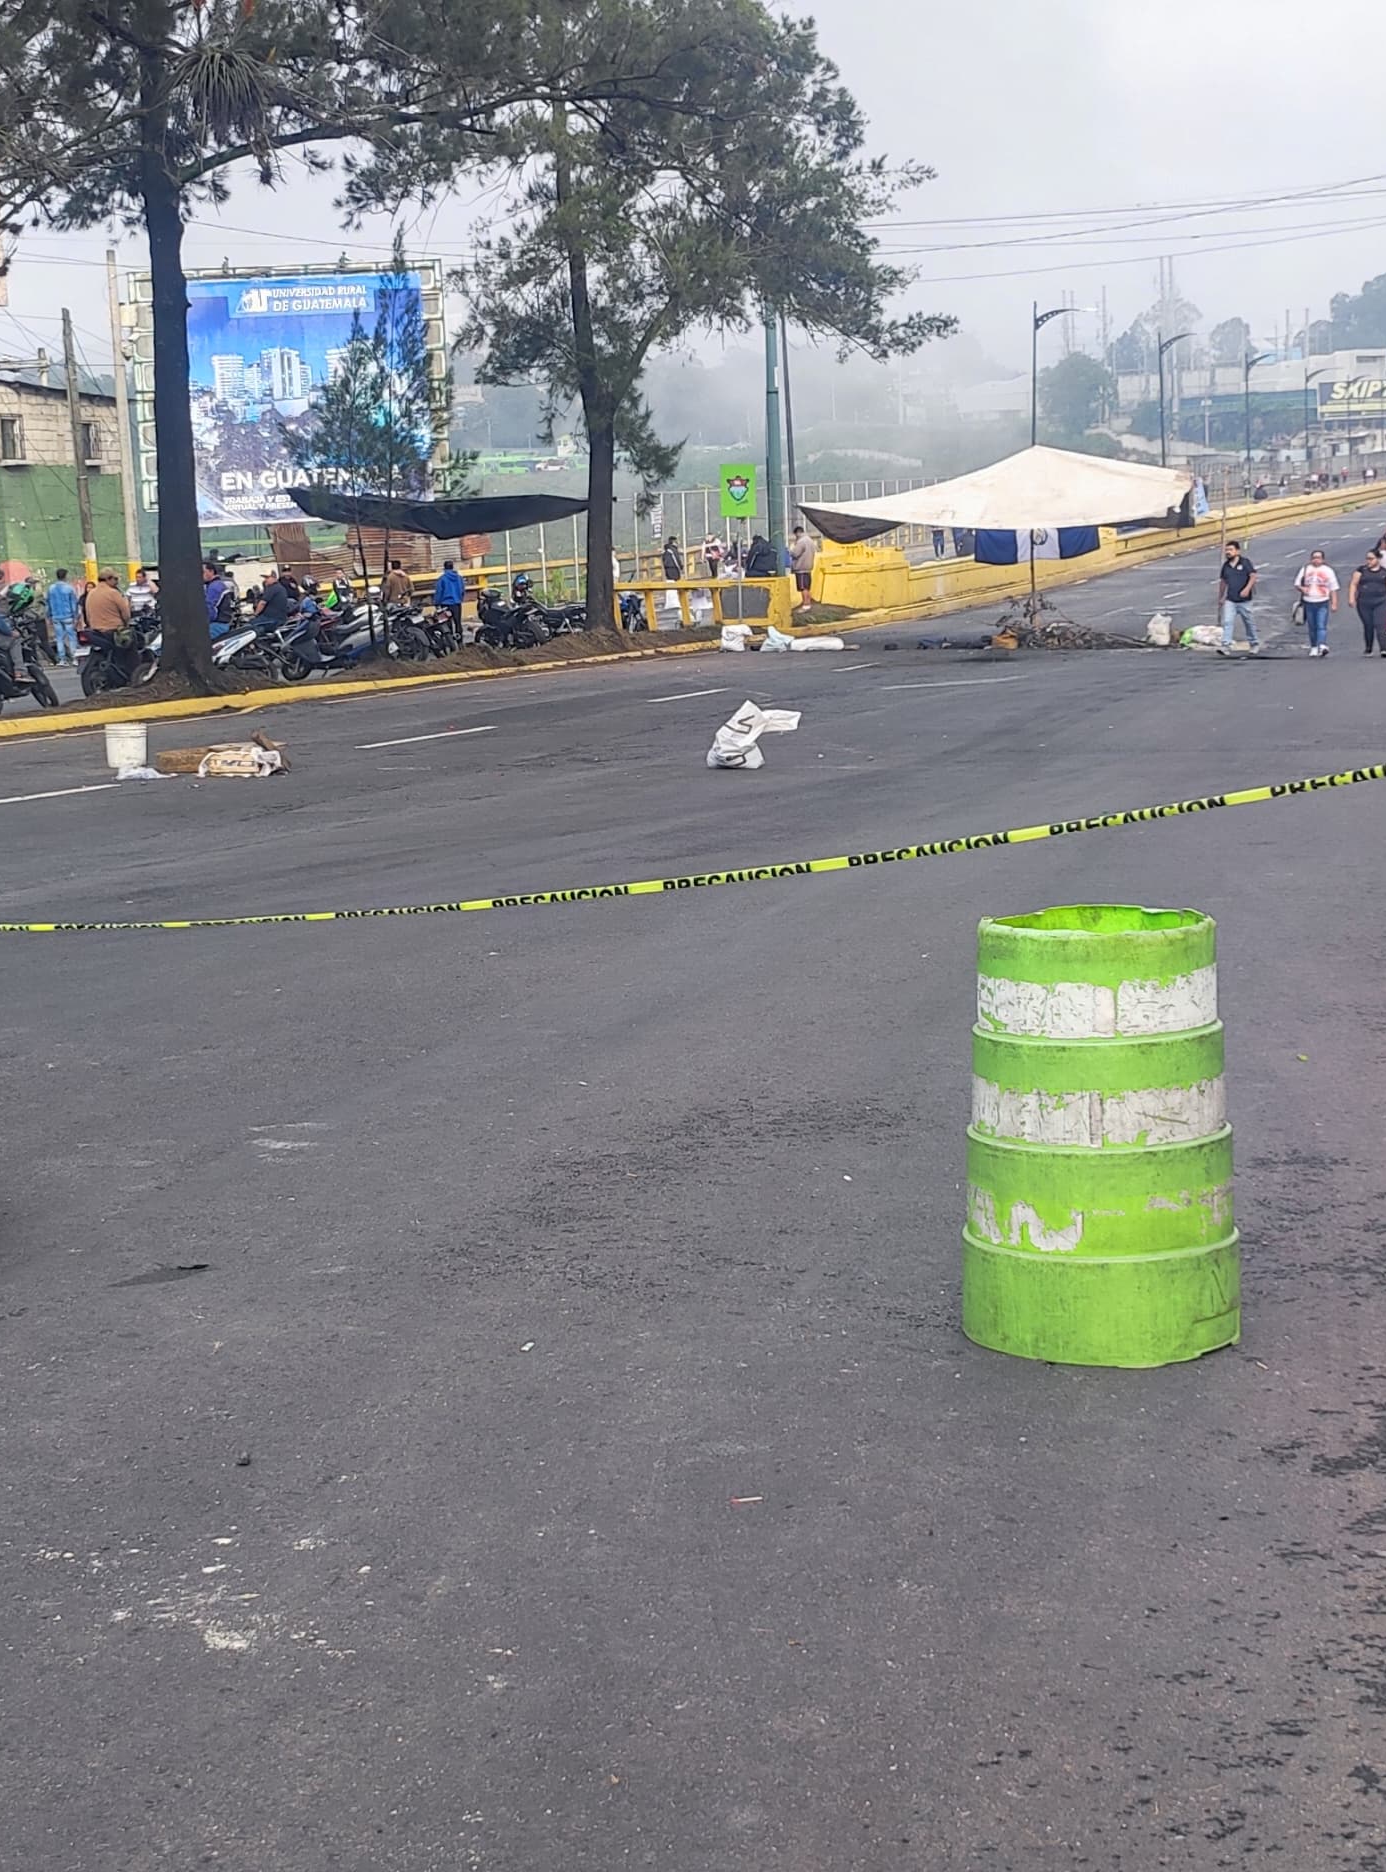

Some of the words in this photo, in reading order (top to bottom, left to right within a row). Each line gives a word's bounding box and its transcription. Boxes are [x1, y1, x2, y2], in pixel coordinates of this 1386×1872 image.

[273, 286, 336, 299] UNIVERSIDAD
[337, 284, 368, 296] RURAL
[273, 300, 290, 312] DE
[293, 296, 368, 311] GUATEMALA
[221, 471, 253, 490] EN
